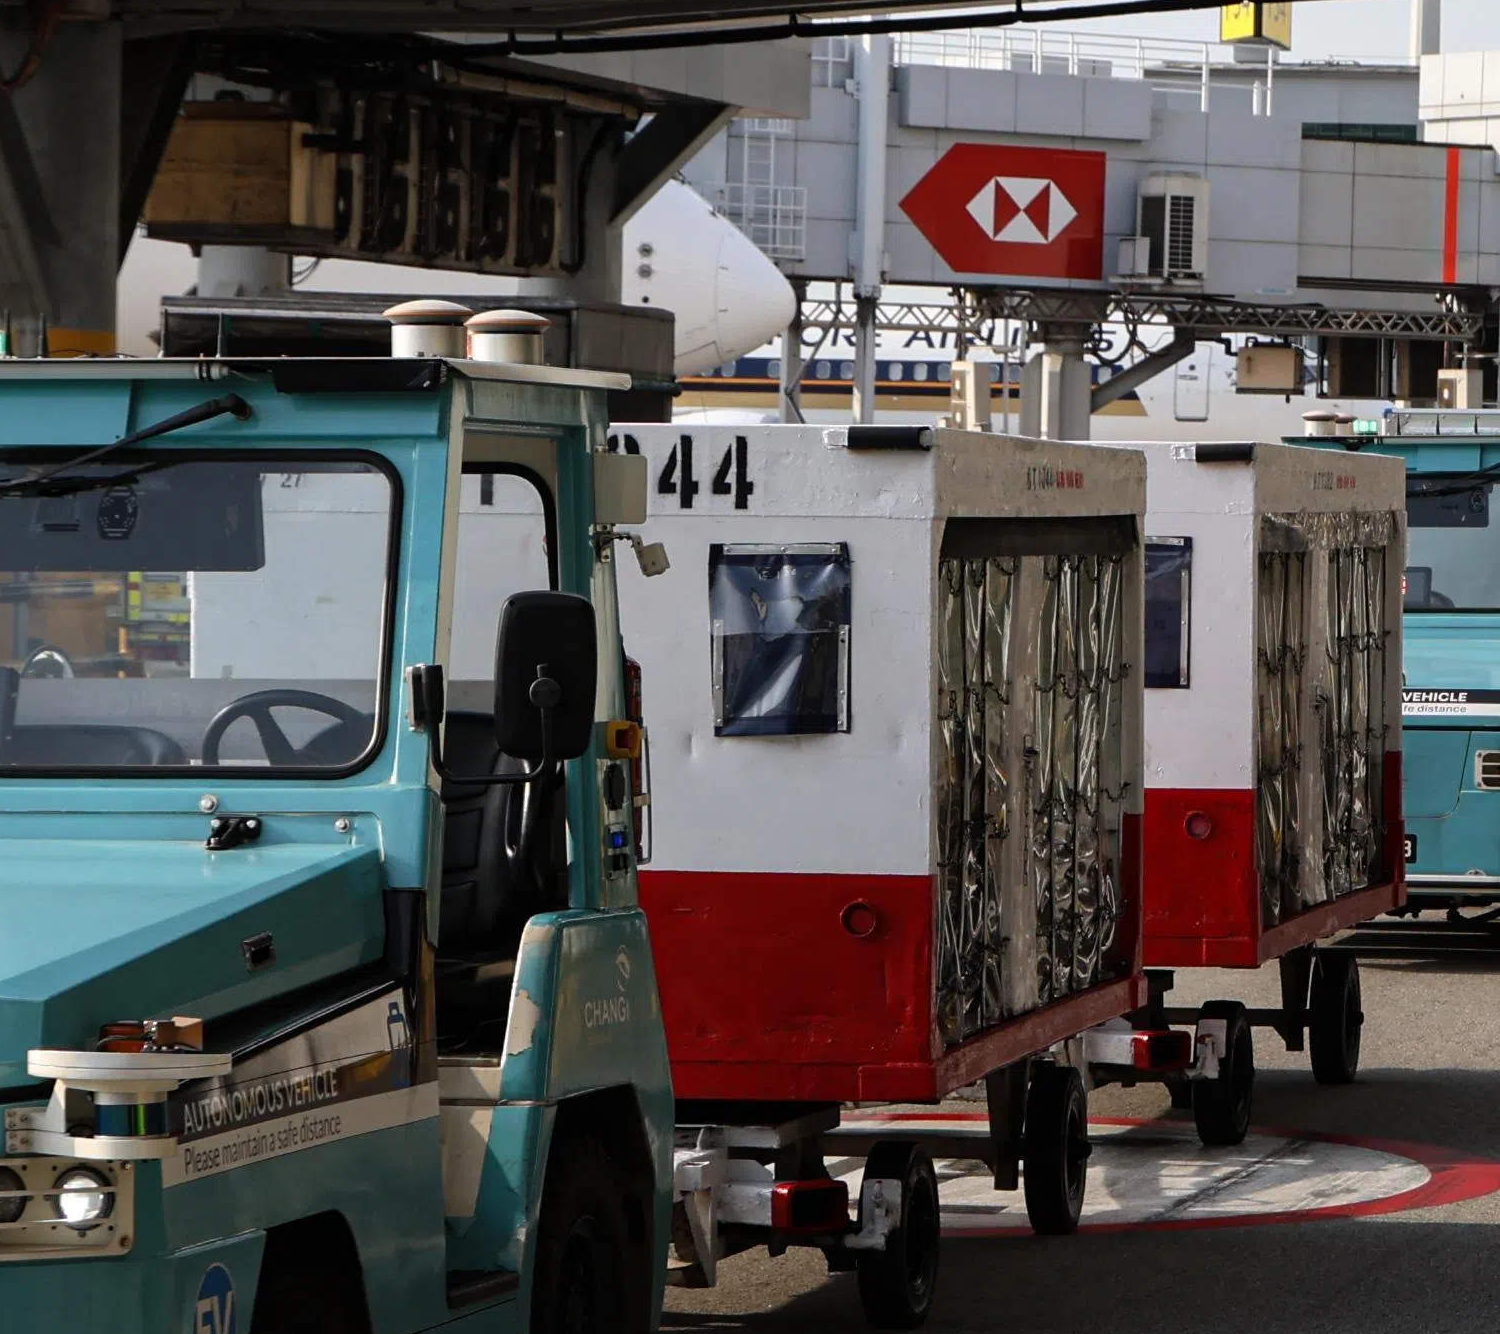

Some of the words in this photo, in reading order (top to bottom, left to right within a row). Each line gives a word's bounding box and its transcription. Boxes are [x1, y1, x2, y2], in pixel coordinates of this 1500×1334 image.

[607, 433, 754, 510] 44
[1402, 692, 1468, 703] VEHICLE
[1417, 704, 1468, 714] distance
[585, 997, 629, 1027] CHANGI
[183, 1077, 286, 1136] AUTONOMOUS
[284, 1067, 339, 1108] VEHICLE
[184, 1147, 221, 1175] Please
[221, 1128, 268, 1166] maintain
[277, 1121, 298, 1150] safe
[300, 1115, 341, 1144] distance
